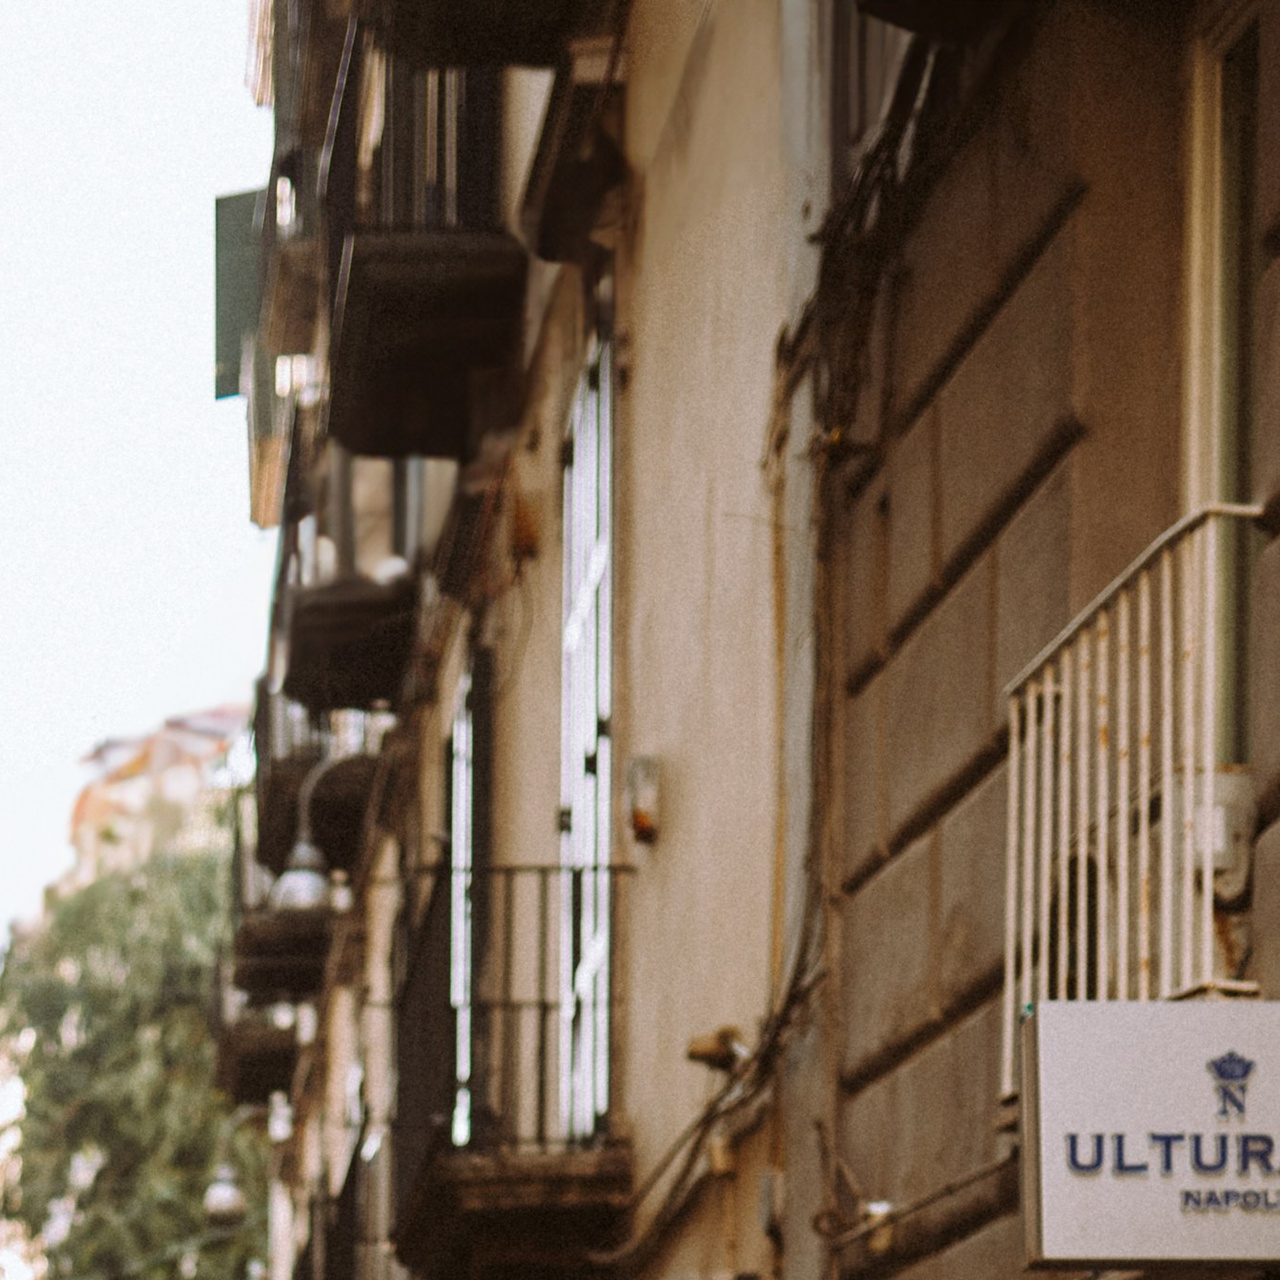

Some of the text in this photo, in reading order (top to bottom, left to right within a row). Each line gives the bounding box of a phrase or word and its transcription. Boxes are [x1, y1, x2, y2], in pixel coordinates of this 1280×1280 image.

[1216, 1085, 1248, 1117] N
[1066, 1132, 1280, 1175] ULTUR
[1181, 1189, 1280, 1213] NAPOL
